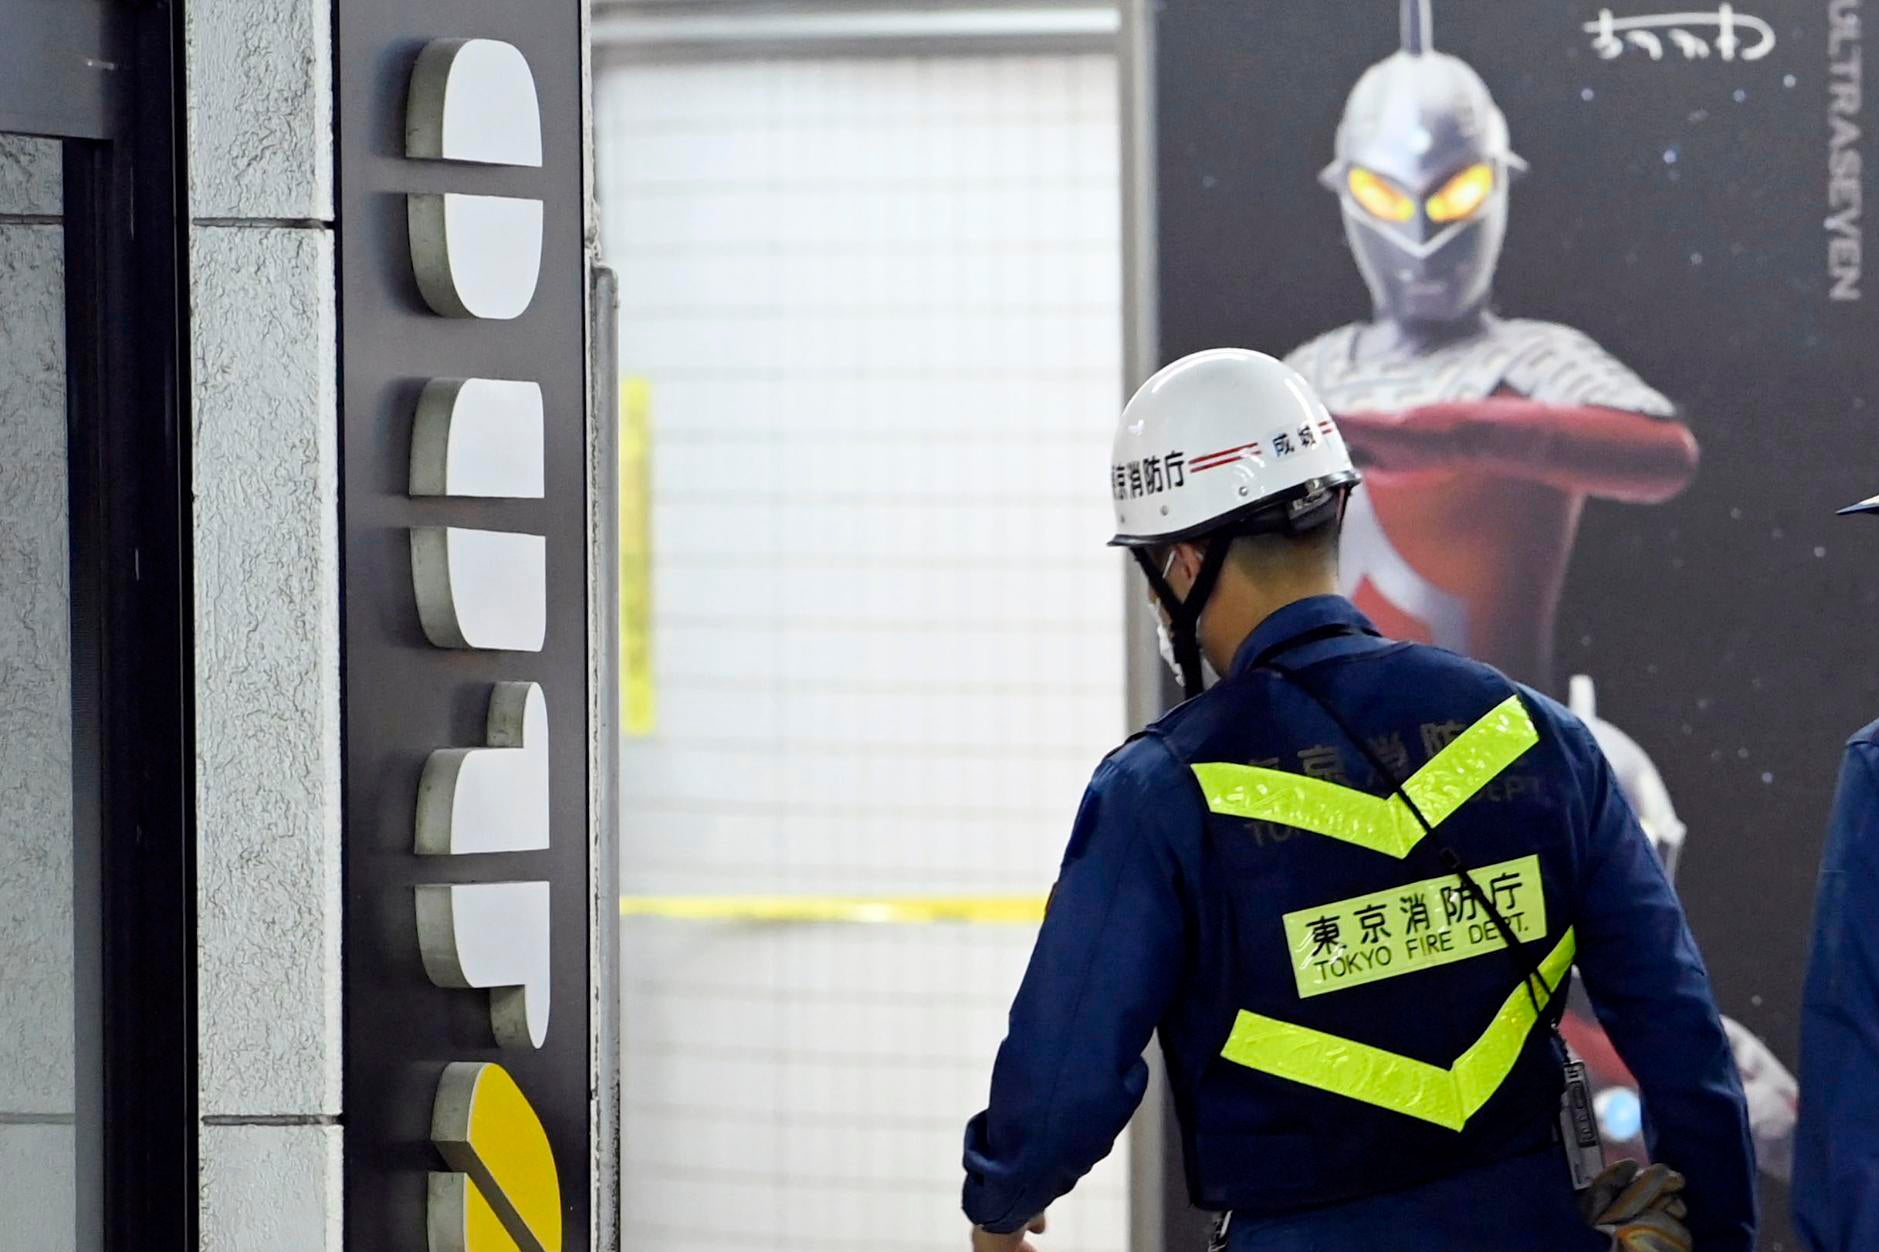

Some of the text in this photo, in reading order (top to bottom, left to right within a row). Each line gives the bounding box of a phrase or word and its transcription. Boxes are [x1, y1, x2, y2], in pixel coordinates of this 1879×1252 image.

[1112, 451, 1184, 500] 京消防庁
[1306, 872, 1524, 957] 東京消防庁
[1314, 945, 1392, 981] TOKYO
[1406, 930, 1454, 960] FIRE
